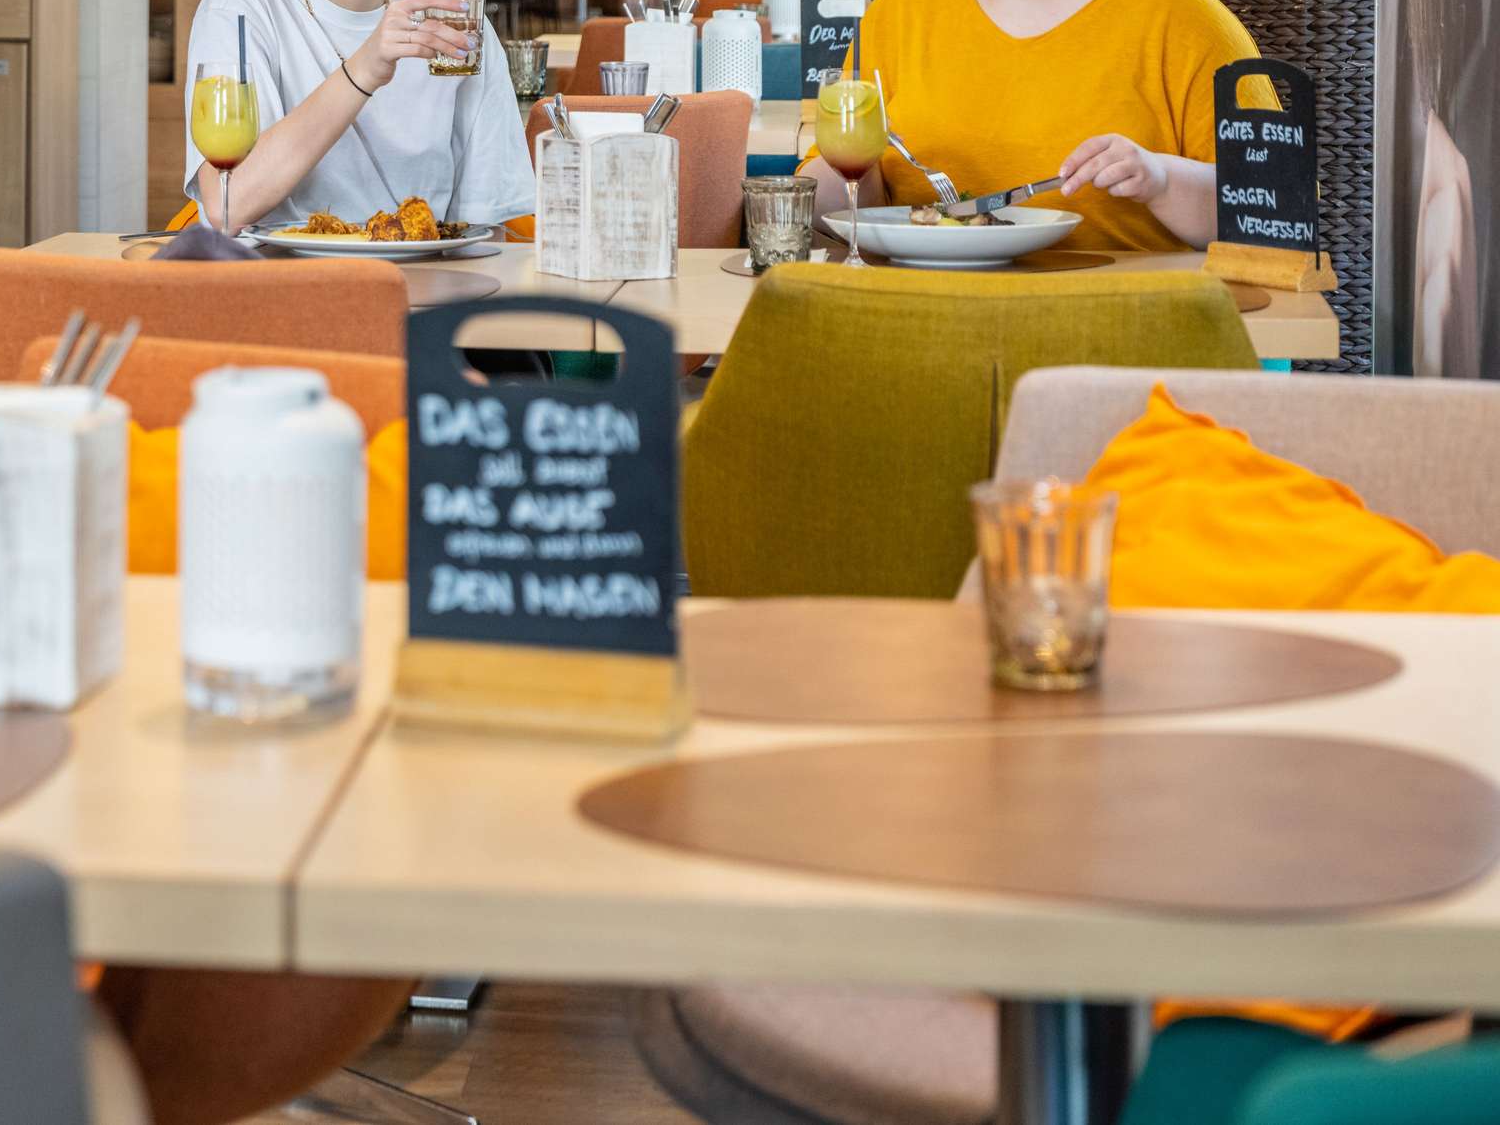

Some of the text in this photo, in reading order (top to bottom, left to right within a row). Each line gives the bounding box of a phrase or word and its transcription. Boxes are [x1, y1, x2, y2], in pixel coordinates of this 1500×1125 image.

[1262, 121, 1304, 147] ESSEN
[1236, 214, 1314, 243] VERGESSEN
[417, 393, 510, 449] DAS
[422, 483, 499, 526] DAS
[428, 565, 514, 615] DEN
